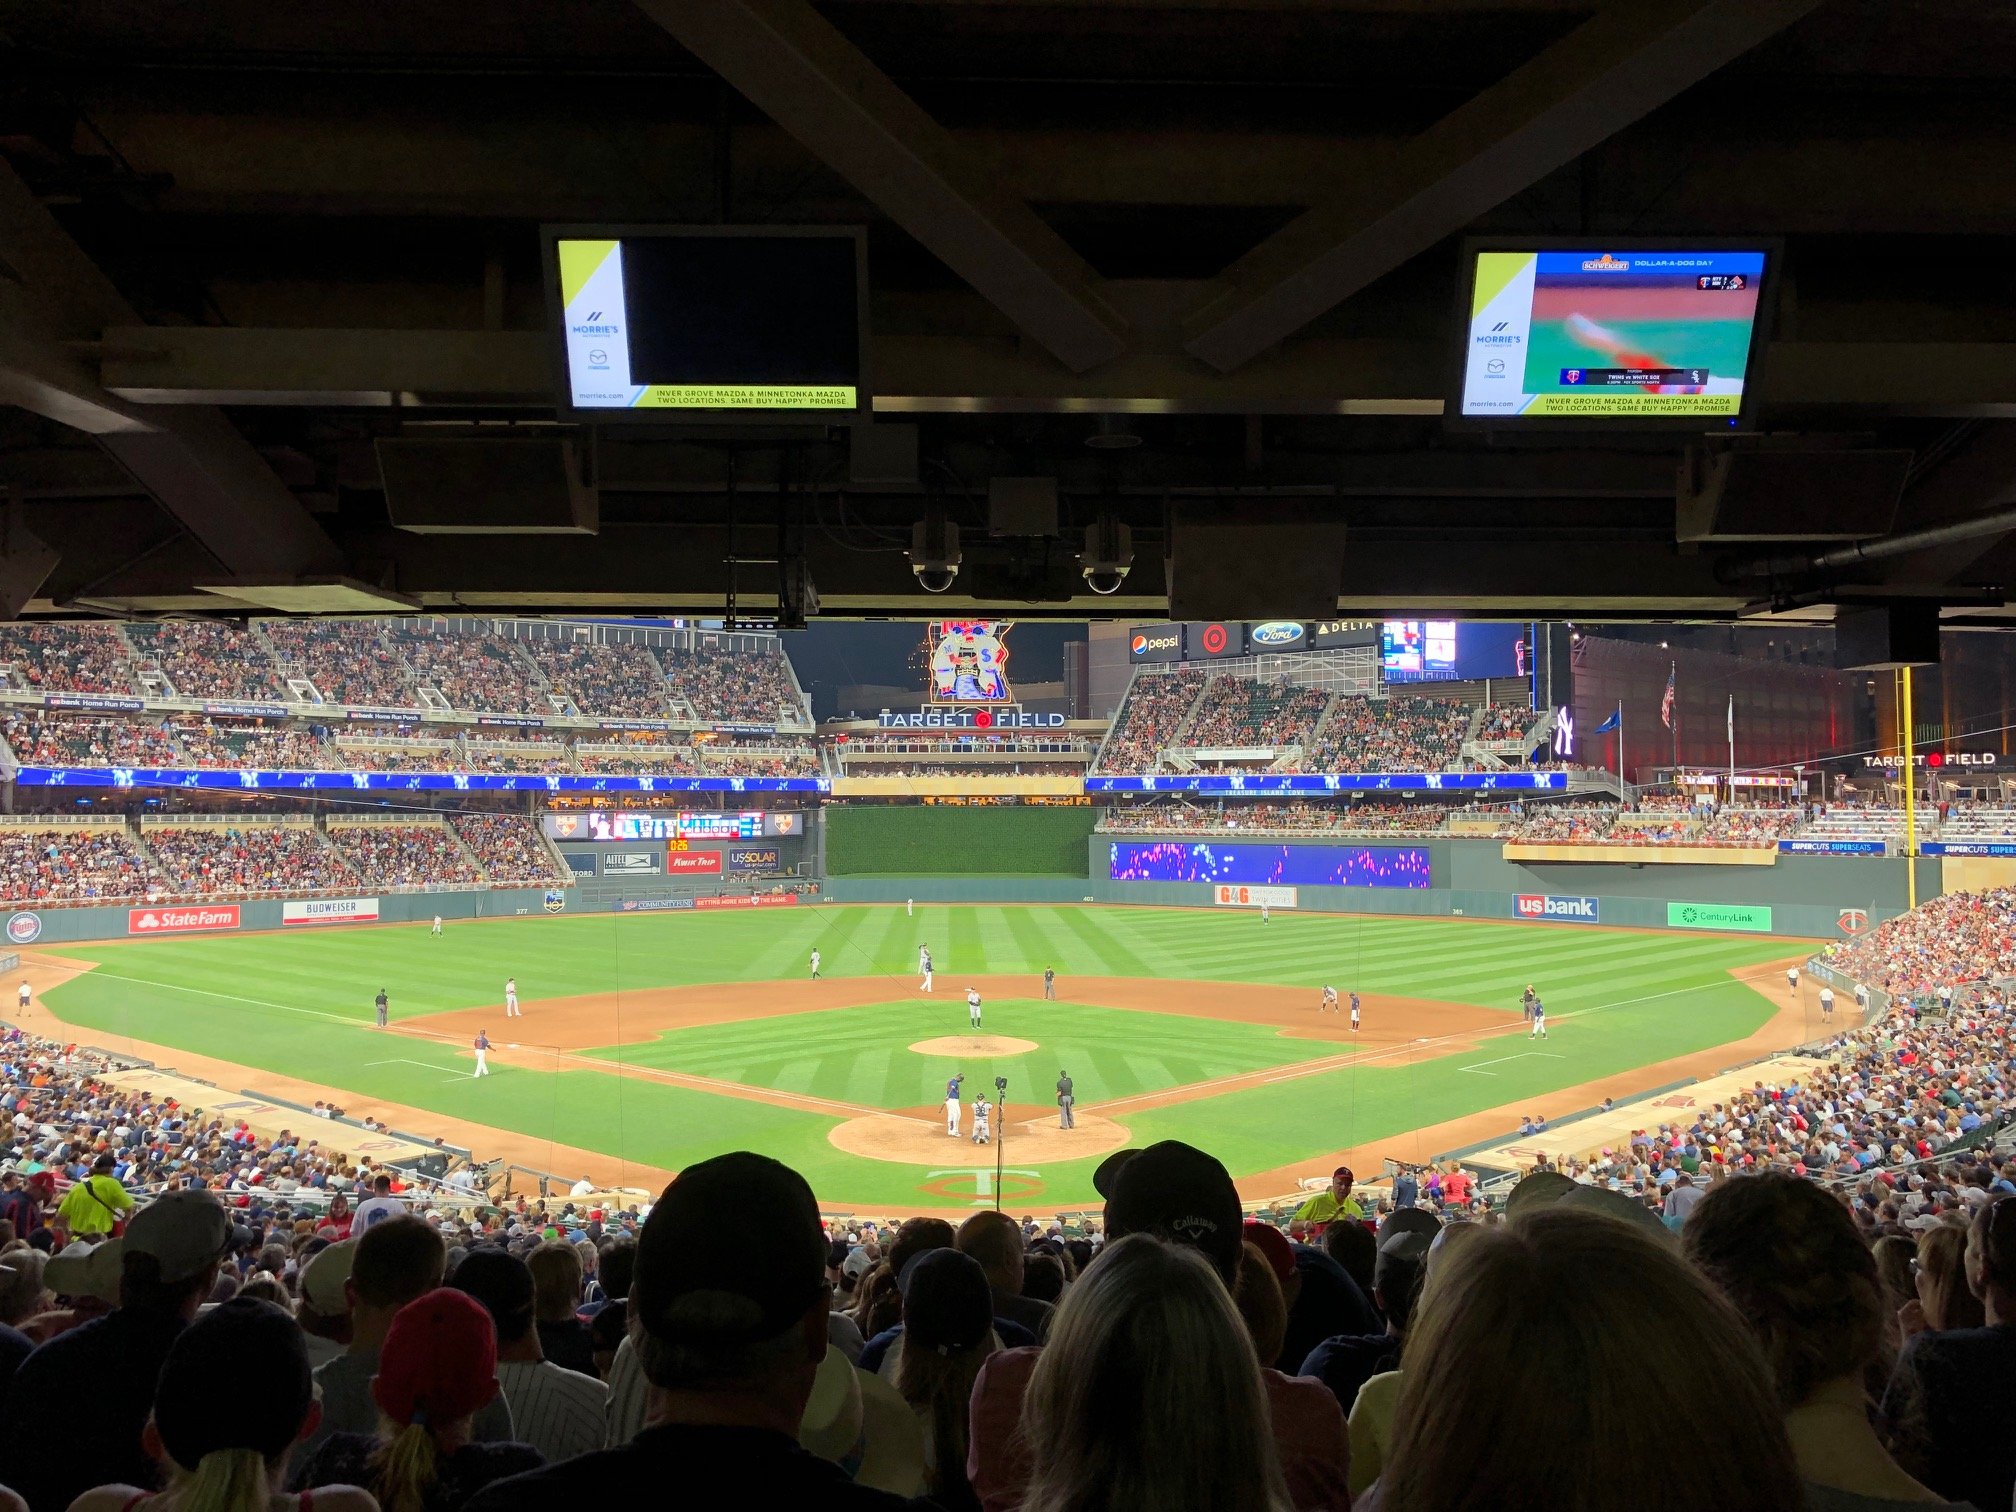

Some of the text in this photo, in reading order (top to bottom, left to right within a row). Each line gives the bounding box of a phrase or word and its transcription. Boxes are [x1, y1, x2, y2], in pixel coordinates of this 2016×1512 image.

[573, 326, 618, 334] MORRIE'S
[1476, 336, 1520, 344] MORRIE'S
[1262, 626, 1292, 640] Ford
[1332, 622, 1374, 632] DELTA
[1148, 635, 1178, 651] pepsi
[878, 714, 1065, 727] TARGET FIELD
[1863, 753, 1996, 766] TARGT FIELD
[670, 840, 688, 850] 0:26
[1221, 887, 1248, 903] G4G
[306, 902, 356, 913] BUDWEISER
[1520, 896, 1594, 916] usbank
[1701, 912, 1753, 923] CenturyLink
[1173, 1216, 1218, 1232] Callaway
